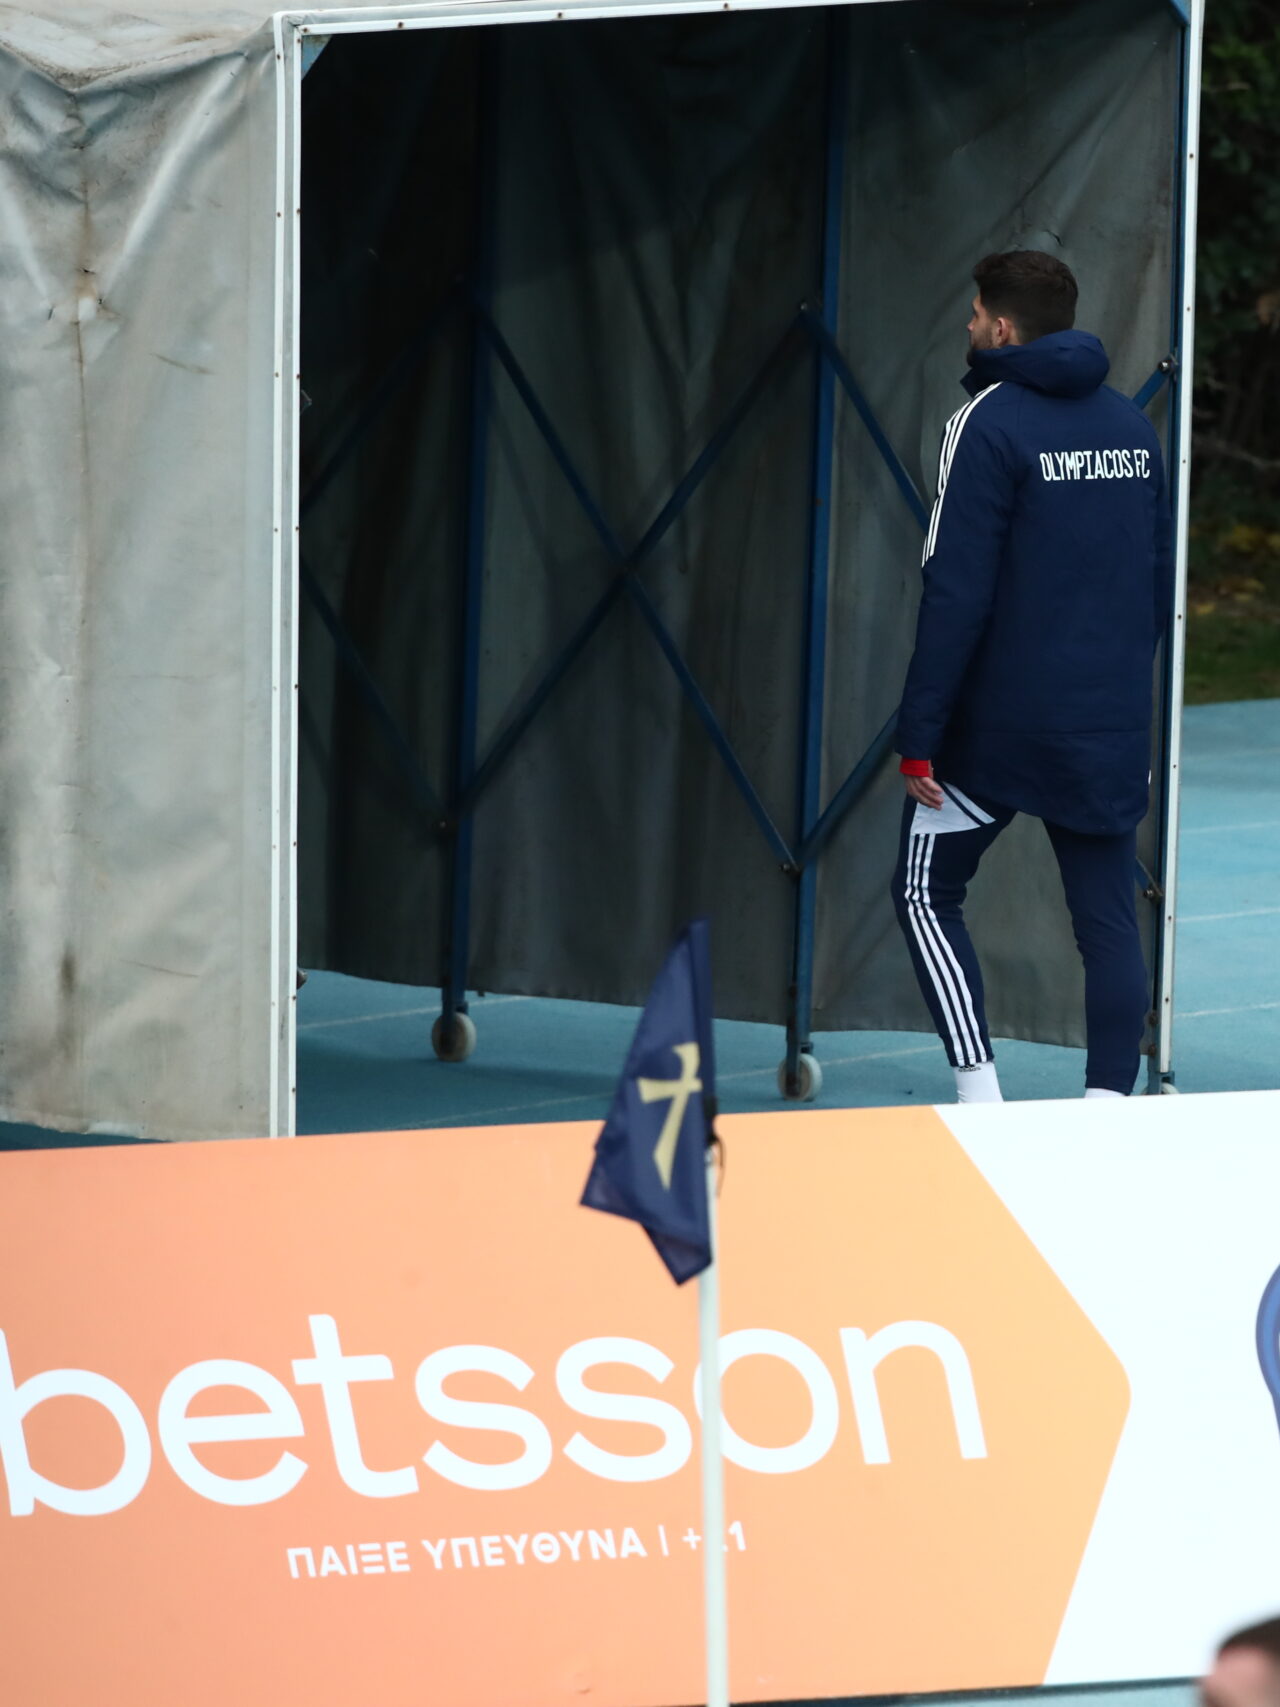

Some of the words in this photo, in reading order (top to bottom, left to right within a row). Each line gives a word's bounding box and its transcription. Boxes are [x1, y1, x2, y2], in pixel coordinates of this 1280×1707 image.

[1039, 449, 1134, 482] OLYMPIACOS
[1133, 449, 1150, 479] FC
[0, 1313, 989, 1517] betsson
[286, 1541, 411, 1579] ΠΑΙΞΕ
[421, 1526, 648, 1570] ΥΠΕΥΘΥΝΑ
